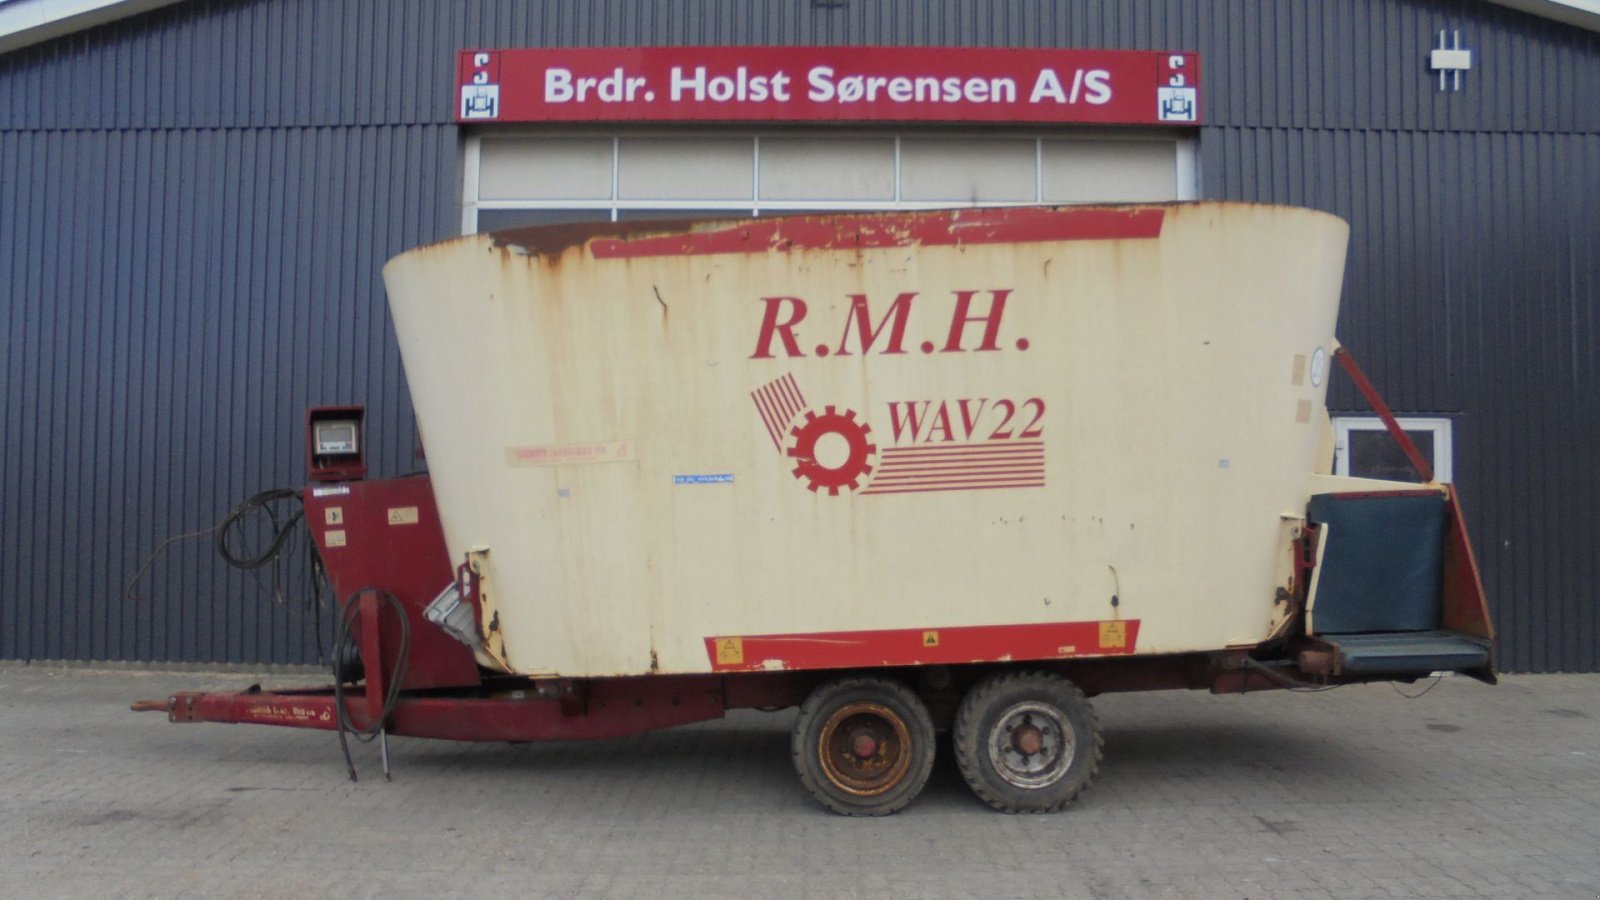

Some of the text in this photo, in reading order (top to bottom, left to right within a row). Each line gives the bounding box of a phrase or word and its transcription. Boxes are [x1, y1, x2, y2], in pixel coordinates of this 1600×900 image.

[544, 66, 1112, 105] Brdr. Holst Sørensen A/S
[749, 289, 1030, 359] R.M.H.
[887, 397, 1047, 445] WAV22
